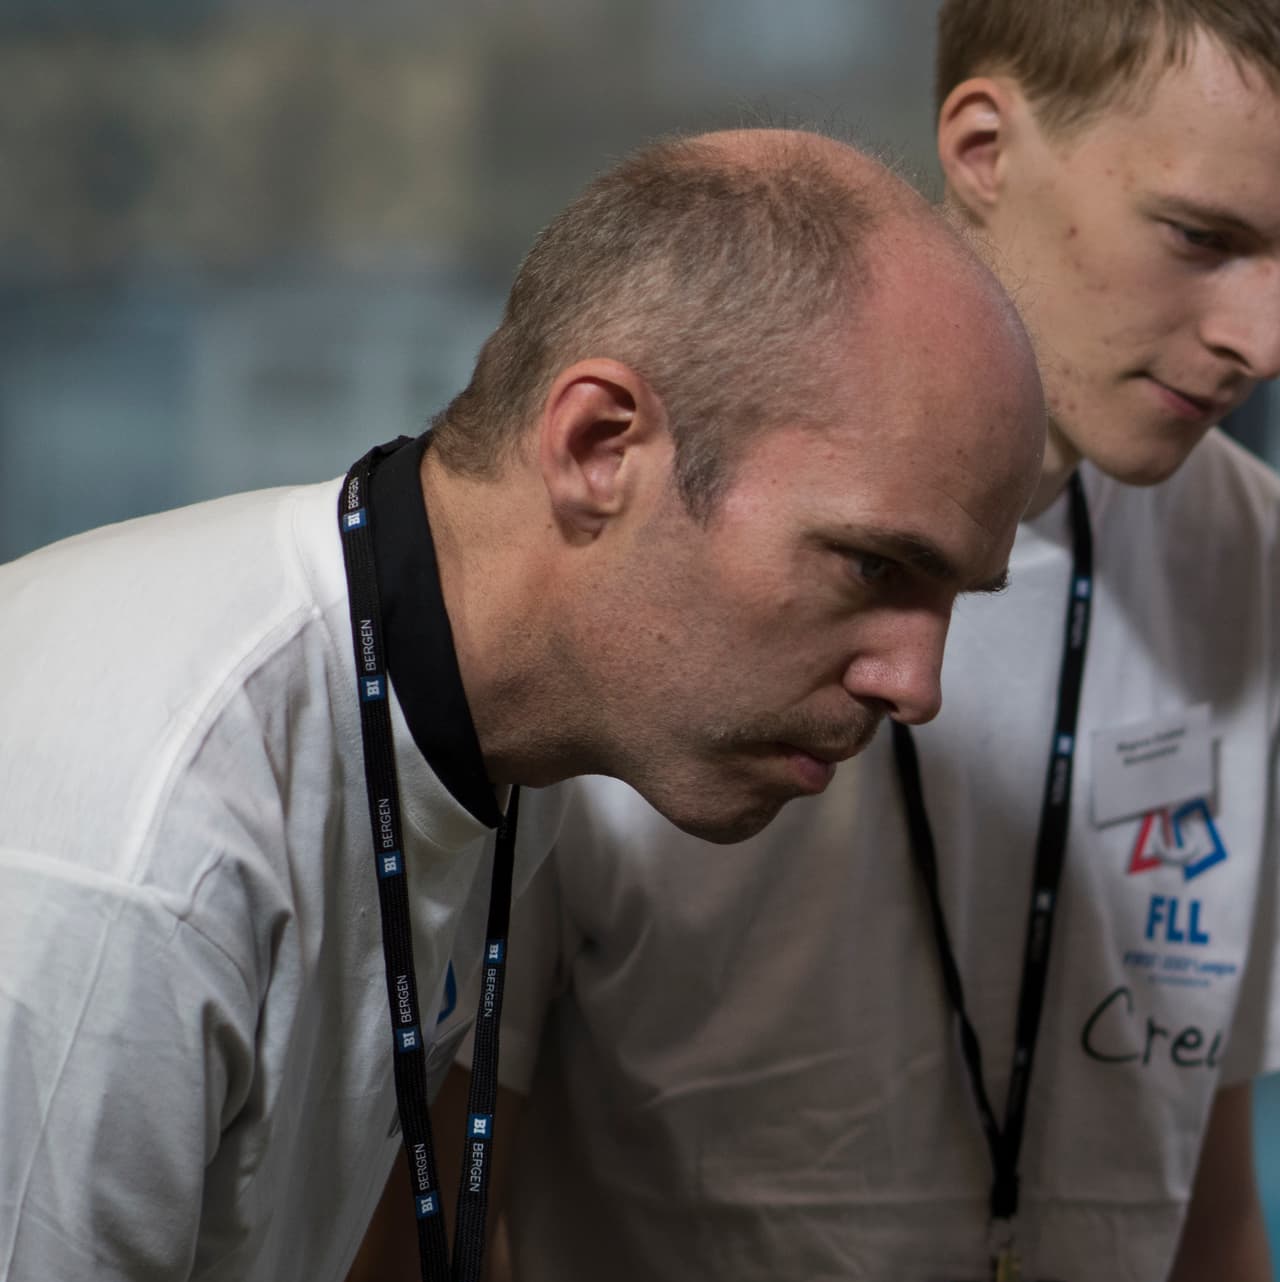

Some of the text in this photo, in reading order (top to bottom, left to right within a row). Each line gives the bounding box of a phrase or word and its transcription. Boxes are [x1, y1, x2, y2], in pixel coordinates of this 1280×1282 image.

[348, 477, 359, 510] BERGEN
[360, 619, 380, 697] BI BERGEN
[378, 798, 397, 873] BI BERGEN
[1145, 895, 1209, 945] FLL
[395, 974, 415, 1048] BI BERGEN
[483, 944, 499, 1018] BI BERGEN
[413, 1144, 433, 1214] BI BERGEN
[469, 1119, 486, 1193] BI BERGEN
